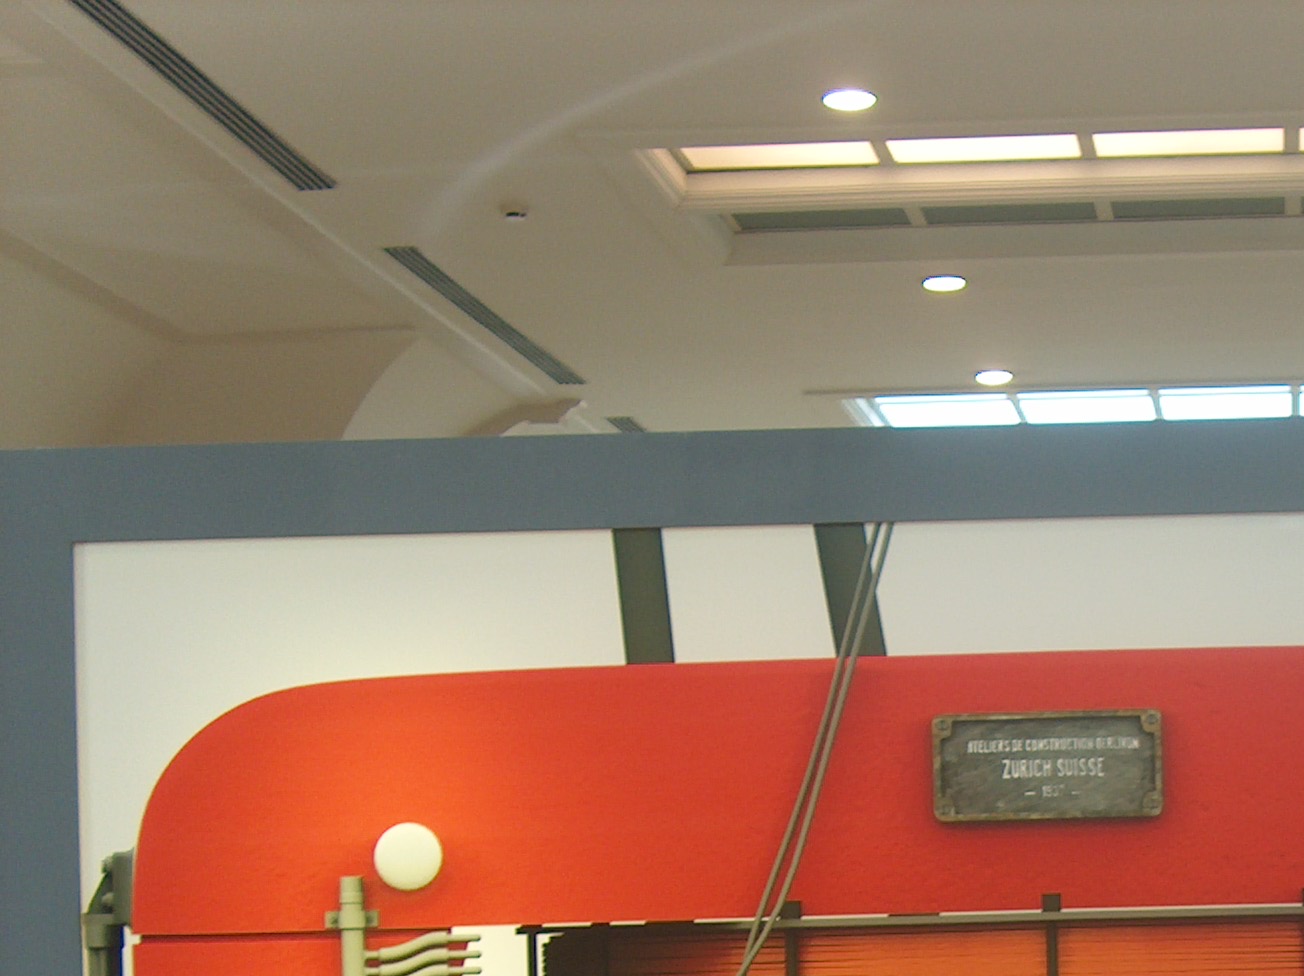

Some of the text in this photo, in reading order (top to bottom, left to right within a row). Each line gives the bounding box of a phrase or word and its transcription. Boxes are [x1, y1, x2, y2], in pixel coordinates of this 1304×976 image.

[967, 740, 1010, 753] ATELIERS
[1012, 738, 1023, 752] DE
[1002, 757, 1105, 779] ZURICH SUISSE
